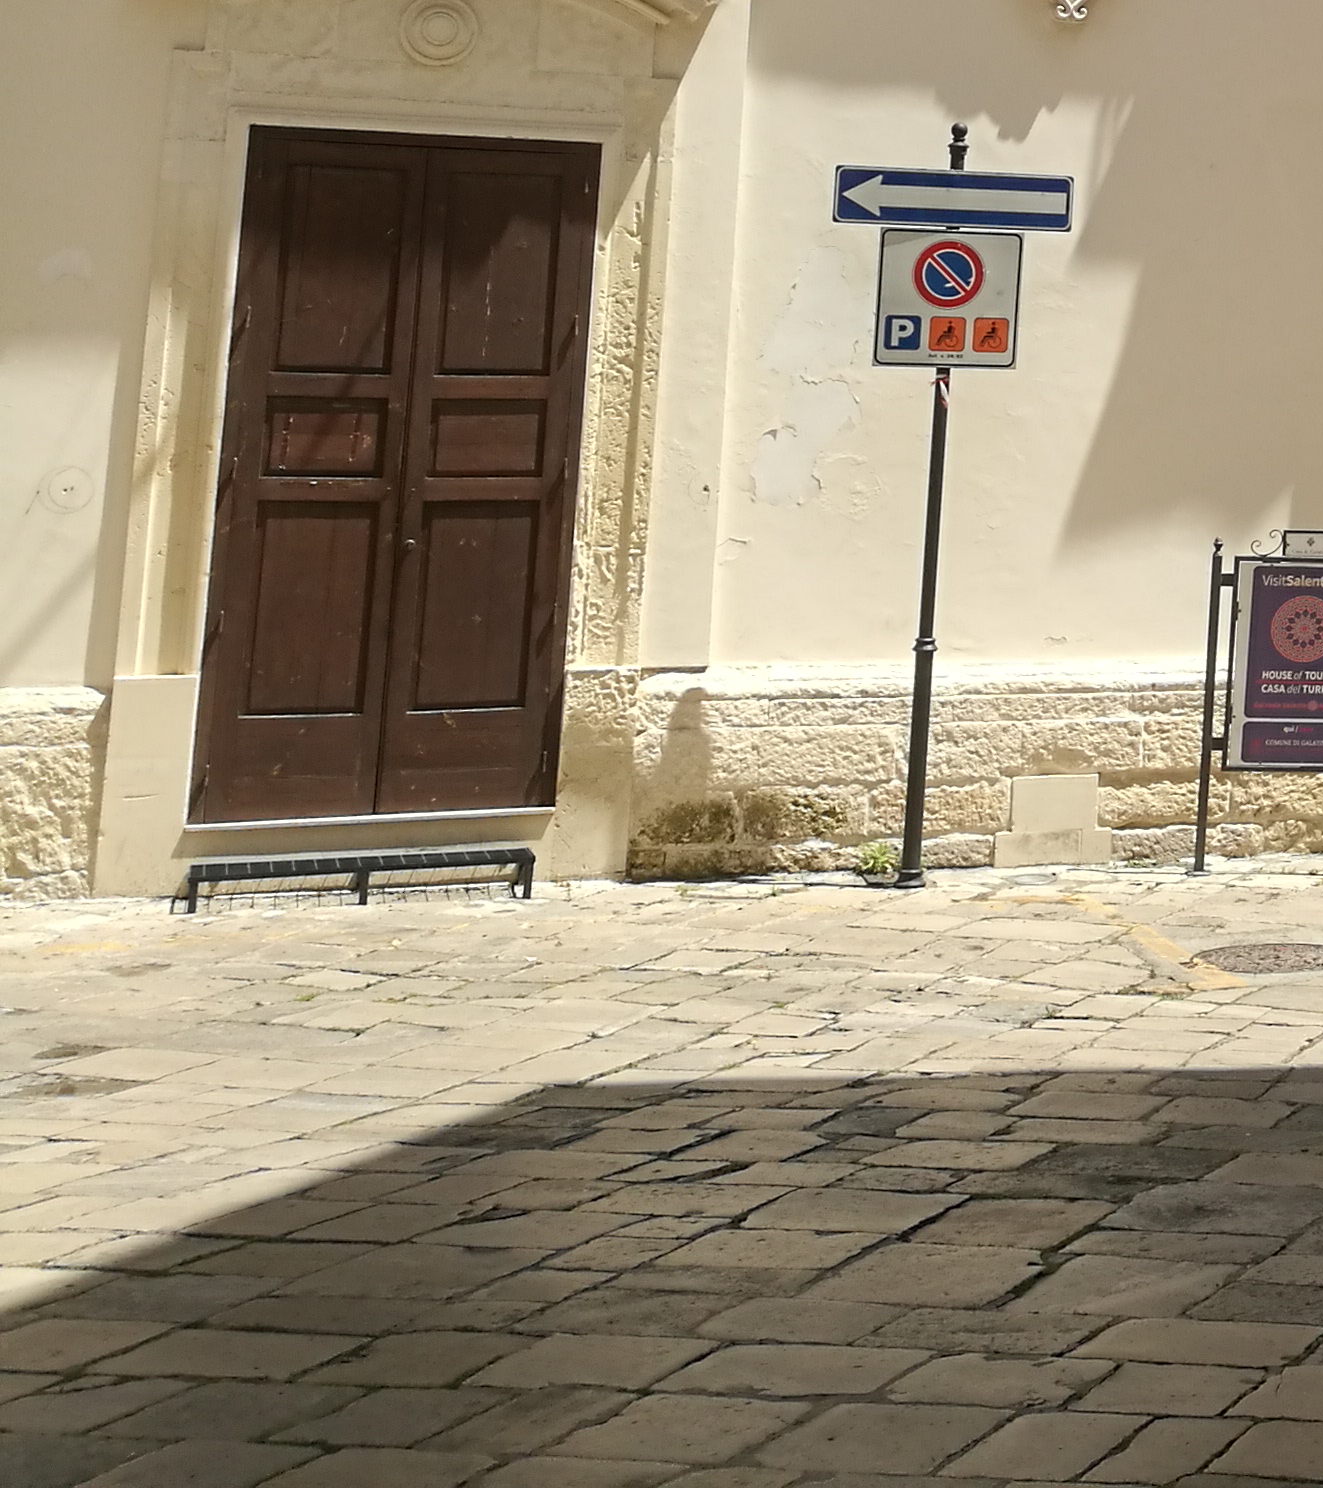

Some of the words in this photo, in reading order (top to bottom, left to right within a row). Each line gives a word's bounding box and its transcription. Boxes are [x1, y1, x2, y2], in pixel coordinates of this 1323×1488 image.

[890, 318, 915, 347] P
[1261, 670, 1293, 680] HOUSE
[1293, 670, 1304, 680] of
[1261, 684, 1286, 693] CASA
[1286, 684, 1300, 693] del
